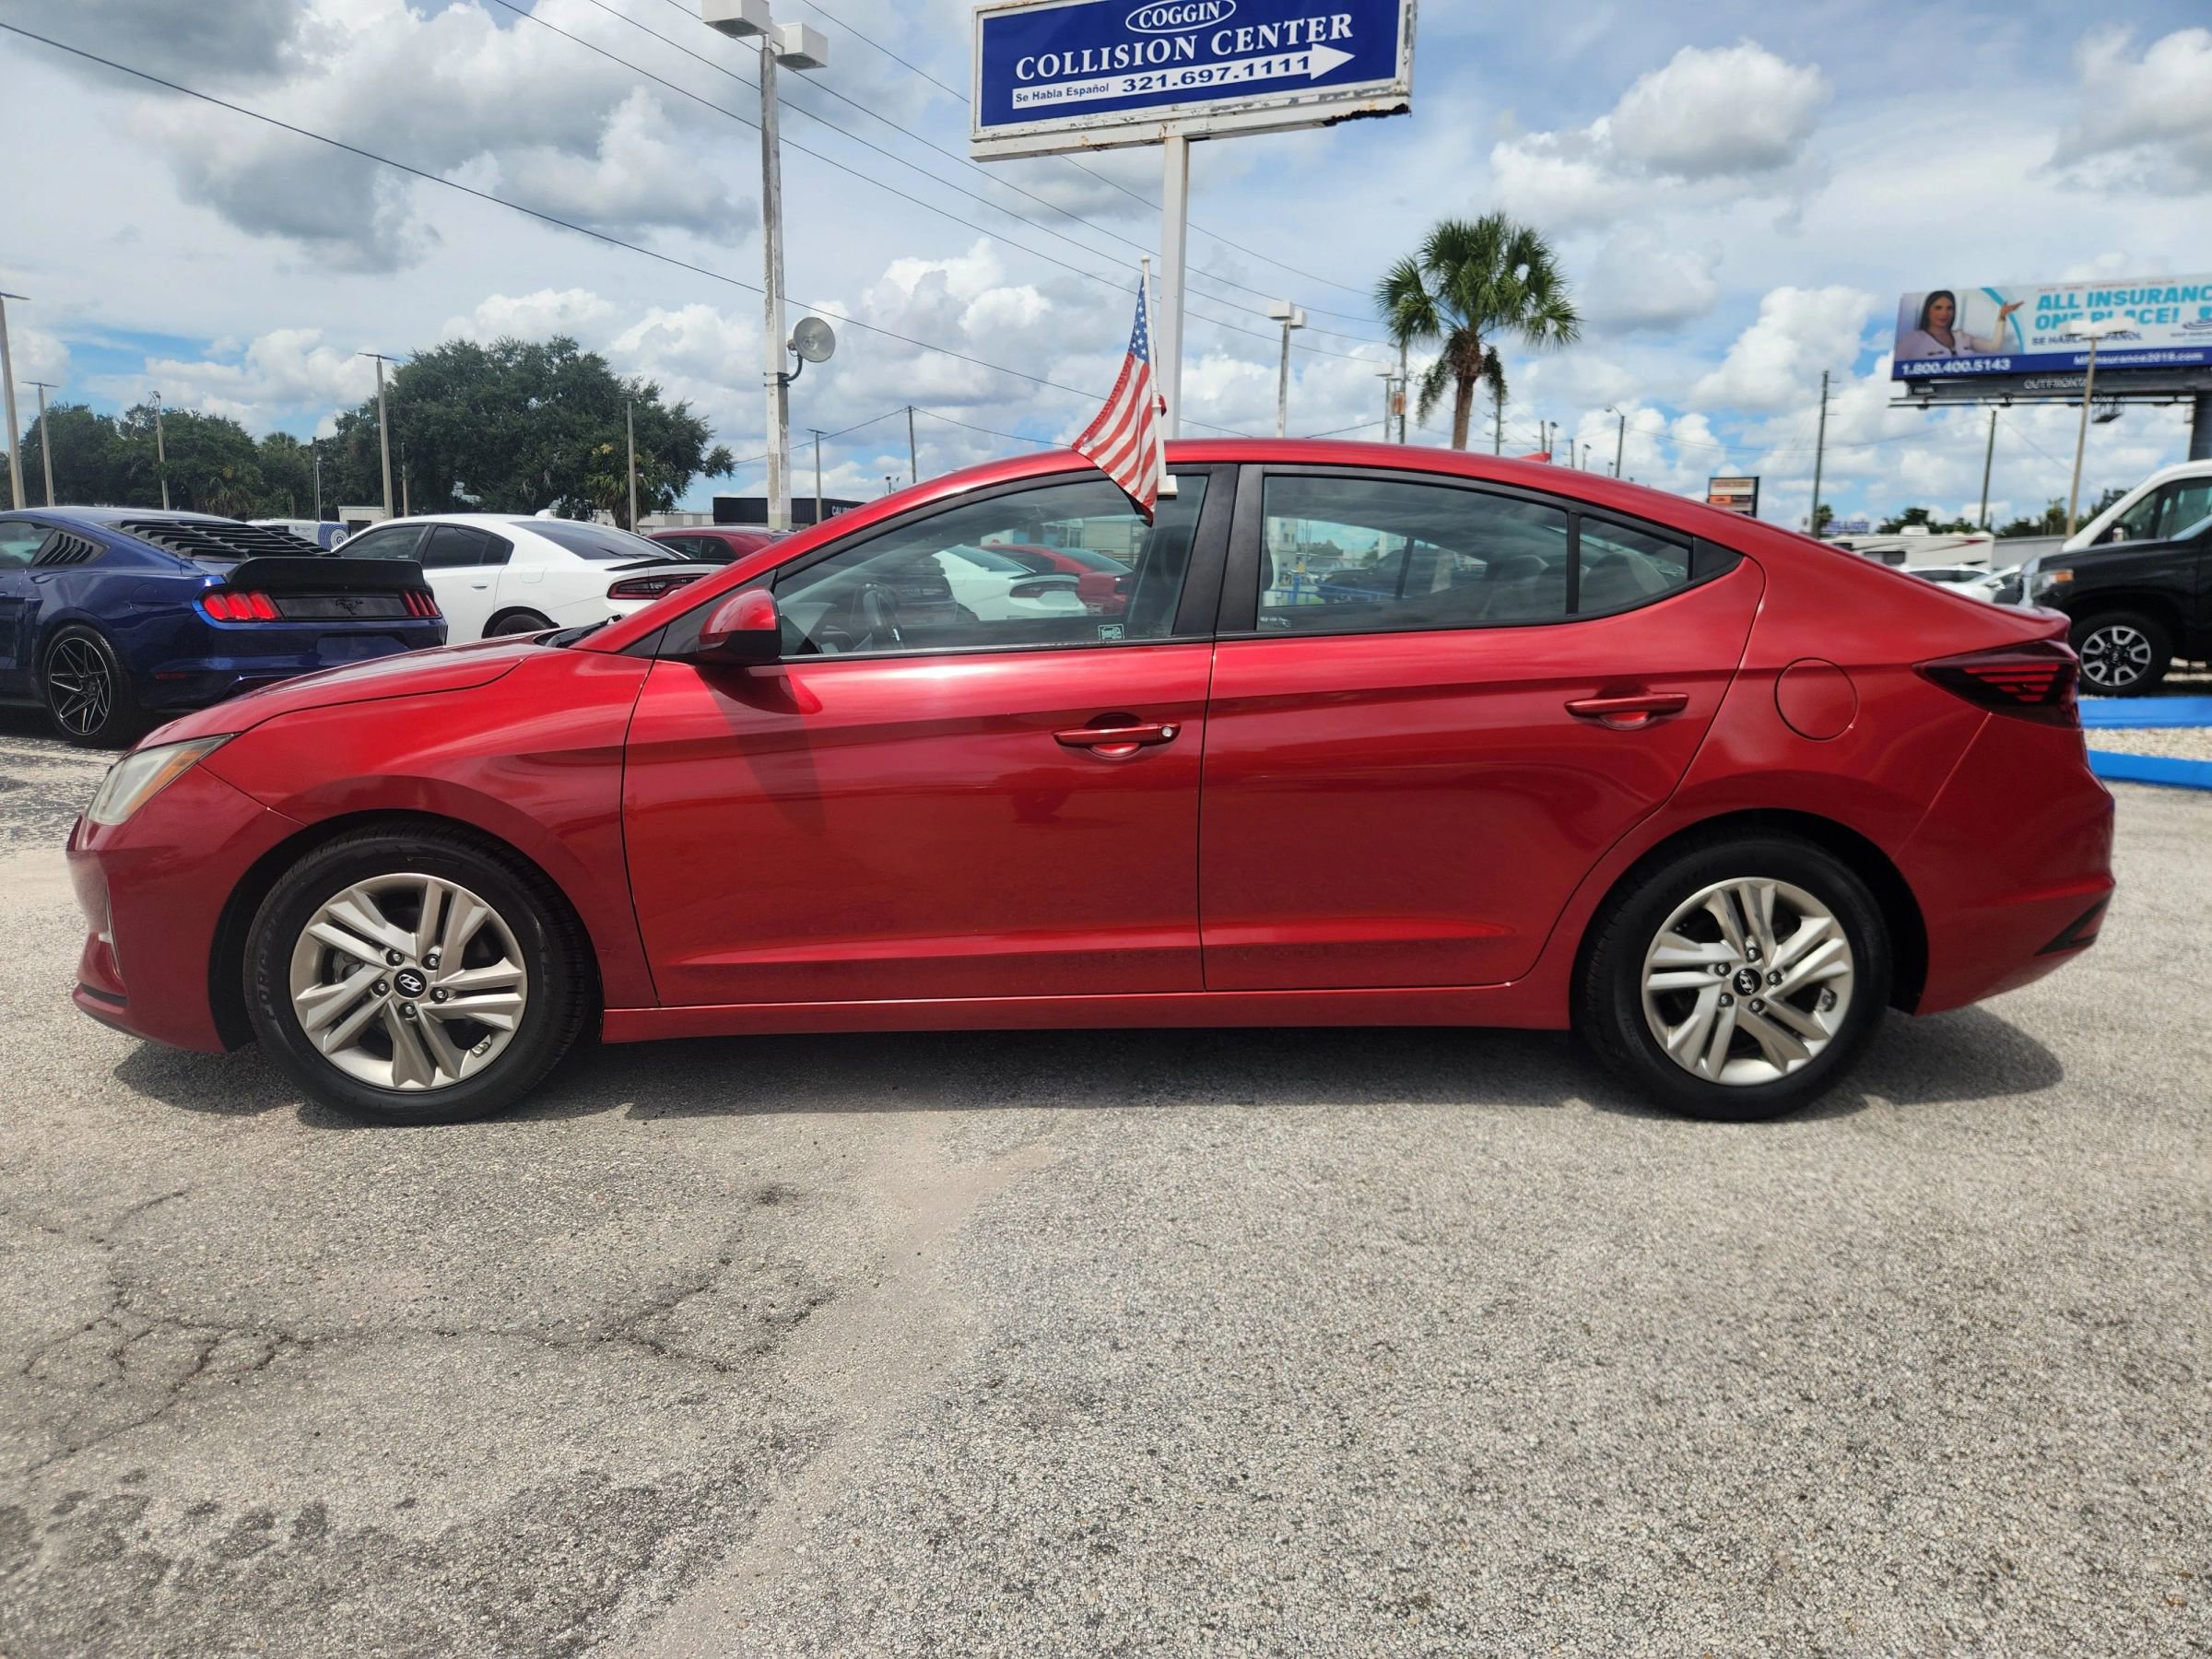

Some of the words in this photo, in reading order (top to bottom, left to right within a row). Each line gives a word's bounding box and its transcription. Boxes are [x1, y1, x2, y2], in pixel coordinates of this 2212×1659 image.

[1138, 1, 1220, 29] COGGIN
[1016, 35, 1197, 80] COLLISION
[1211, 13, 1354, 56] CENTER
[1122, 55, 1309, 93] 321.697.1111
[1016, 93, 1029, 102] Se
[1032, 89, 1063, 100] Habla
[1066, 83, 1110, 99] Español
[2036, 294, 2080, 312] ALL
